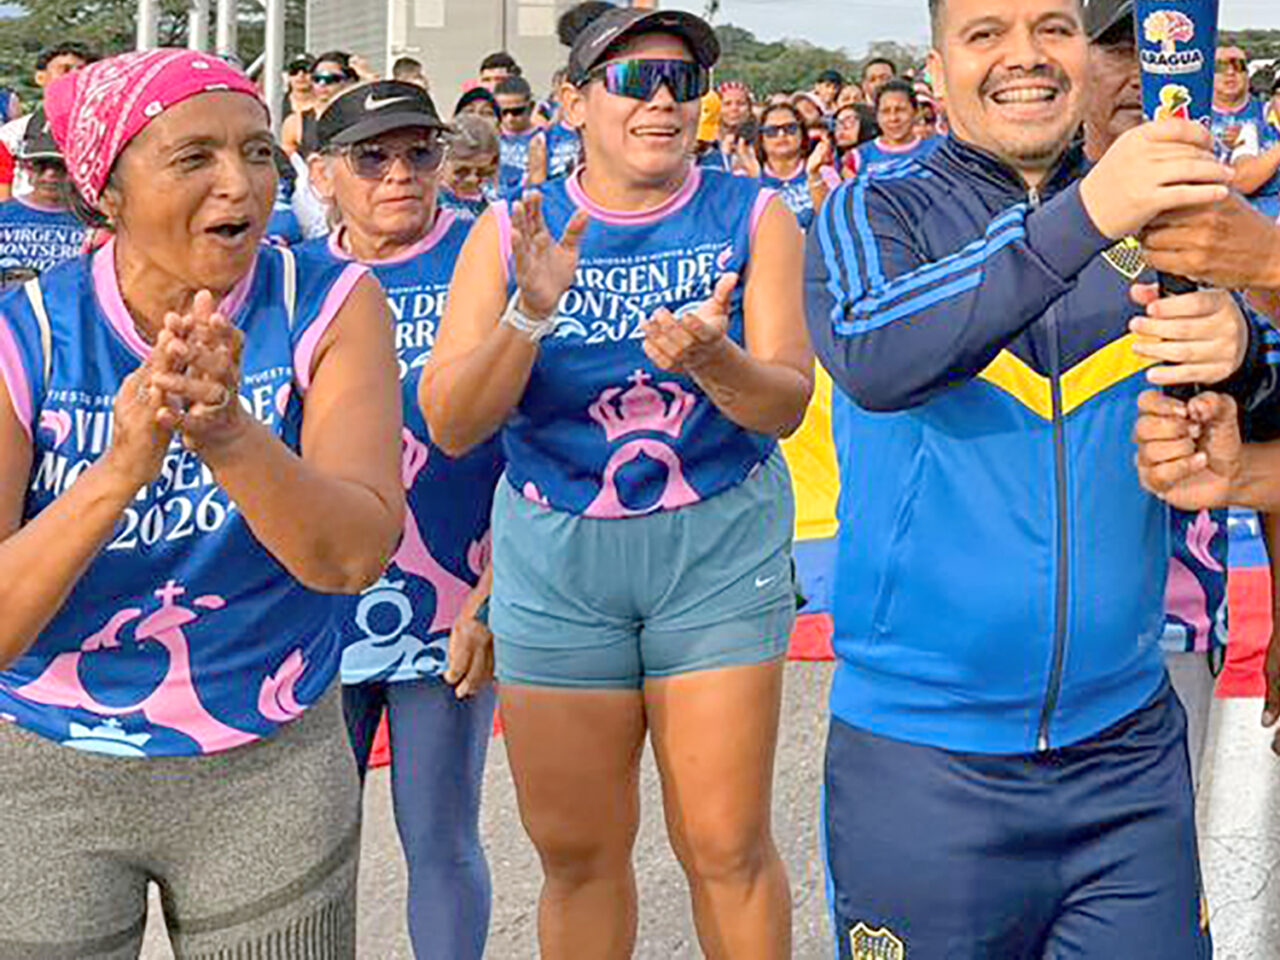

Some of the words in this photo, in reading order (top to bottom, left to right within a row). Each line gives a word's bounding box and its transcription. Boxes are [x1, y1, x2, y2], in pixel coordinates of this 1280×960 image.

[4, 227, 68, 243] VIRGEN
[69, 230, 85, 244] D
[575, 260, 669, 293] IRGEN
[678, 253, 715, 287] DE
[106, 486, 226, 550] 2026
